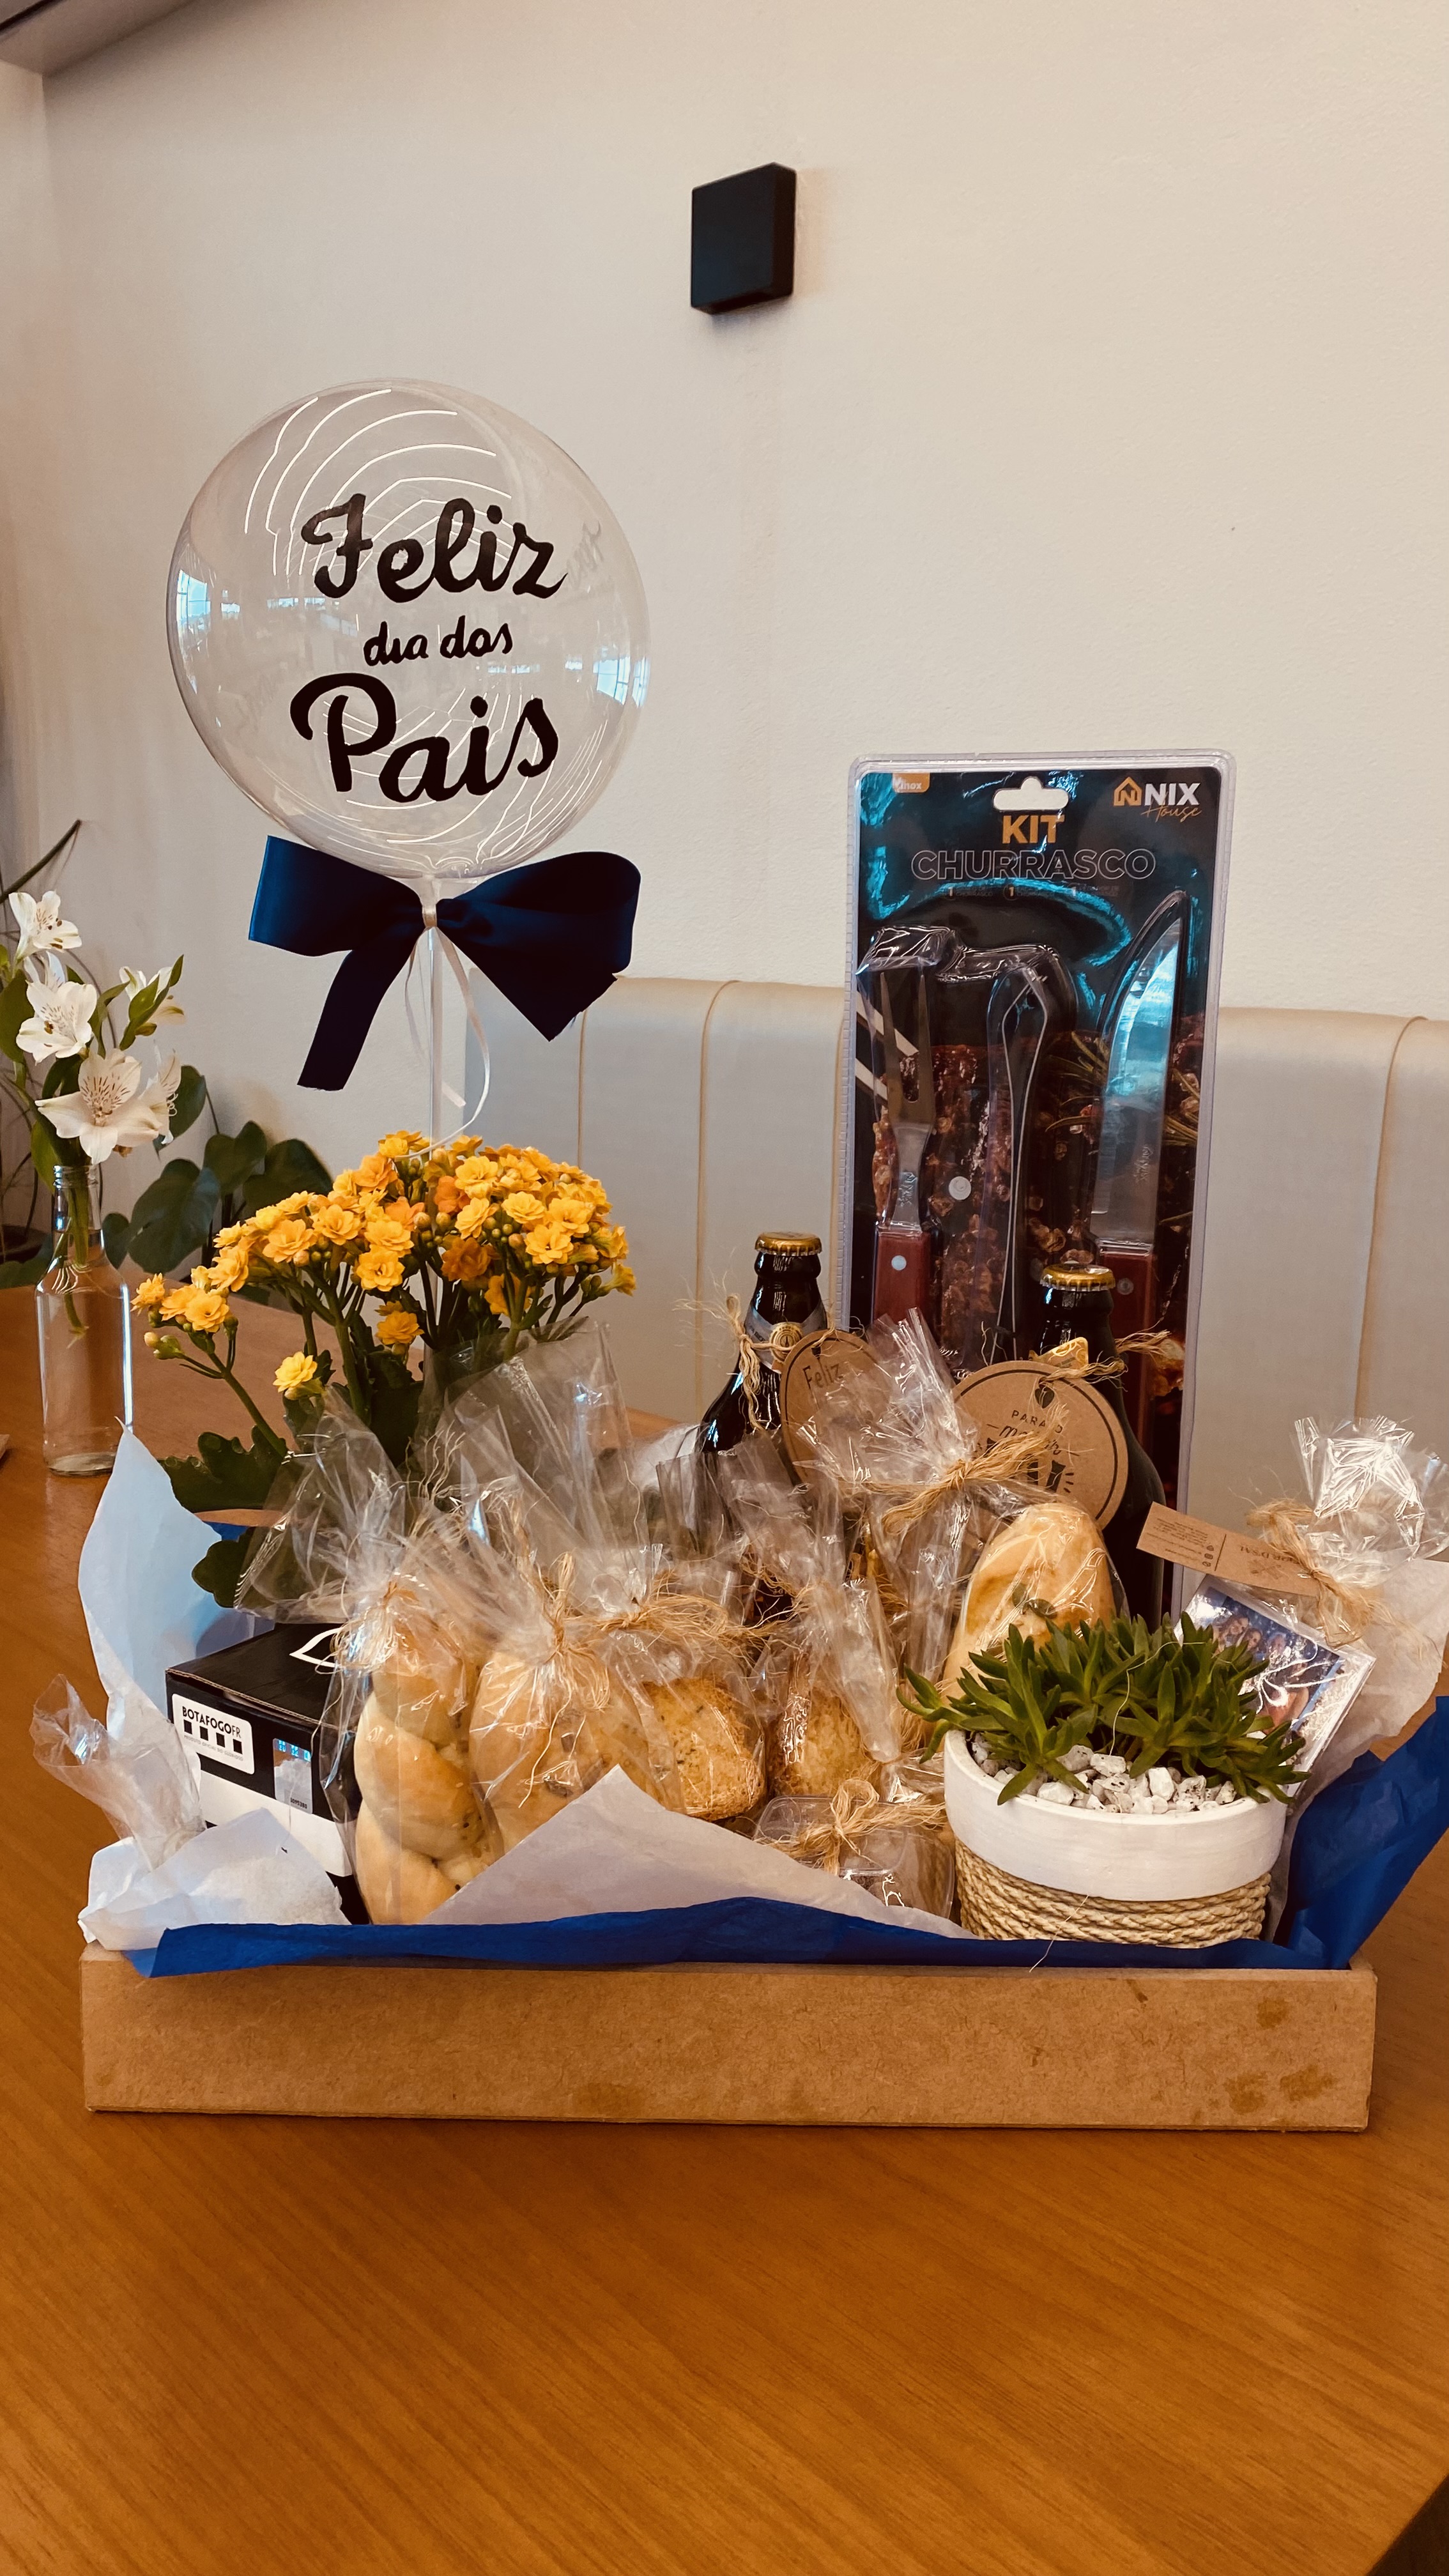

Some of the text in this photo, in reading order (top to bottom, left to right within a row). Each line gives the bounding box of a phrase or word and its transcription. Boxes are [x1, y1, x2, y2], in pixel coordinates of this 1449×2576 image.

[301, 493, 567, 602] Feliz
[364, 615, 513, 666] dia dos
[290, 672, 558, 803] Pais
[1144, 783, 1200, 806] NIX
[1141, 805, 1202, 823] House
[1002, 815, 1065, 844] KIT
[910, 848, 1156, 880] CHURRASCO
[1008, 886, 1015, 897] 1
[802, 1363, 844, 1389] Feliz
[1011, 1409, 1046, 1427] PARA
[182, 1706, 242, 1739] BOTAFOGOFR
